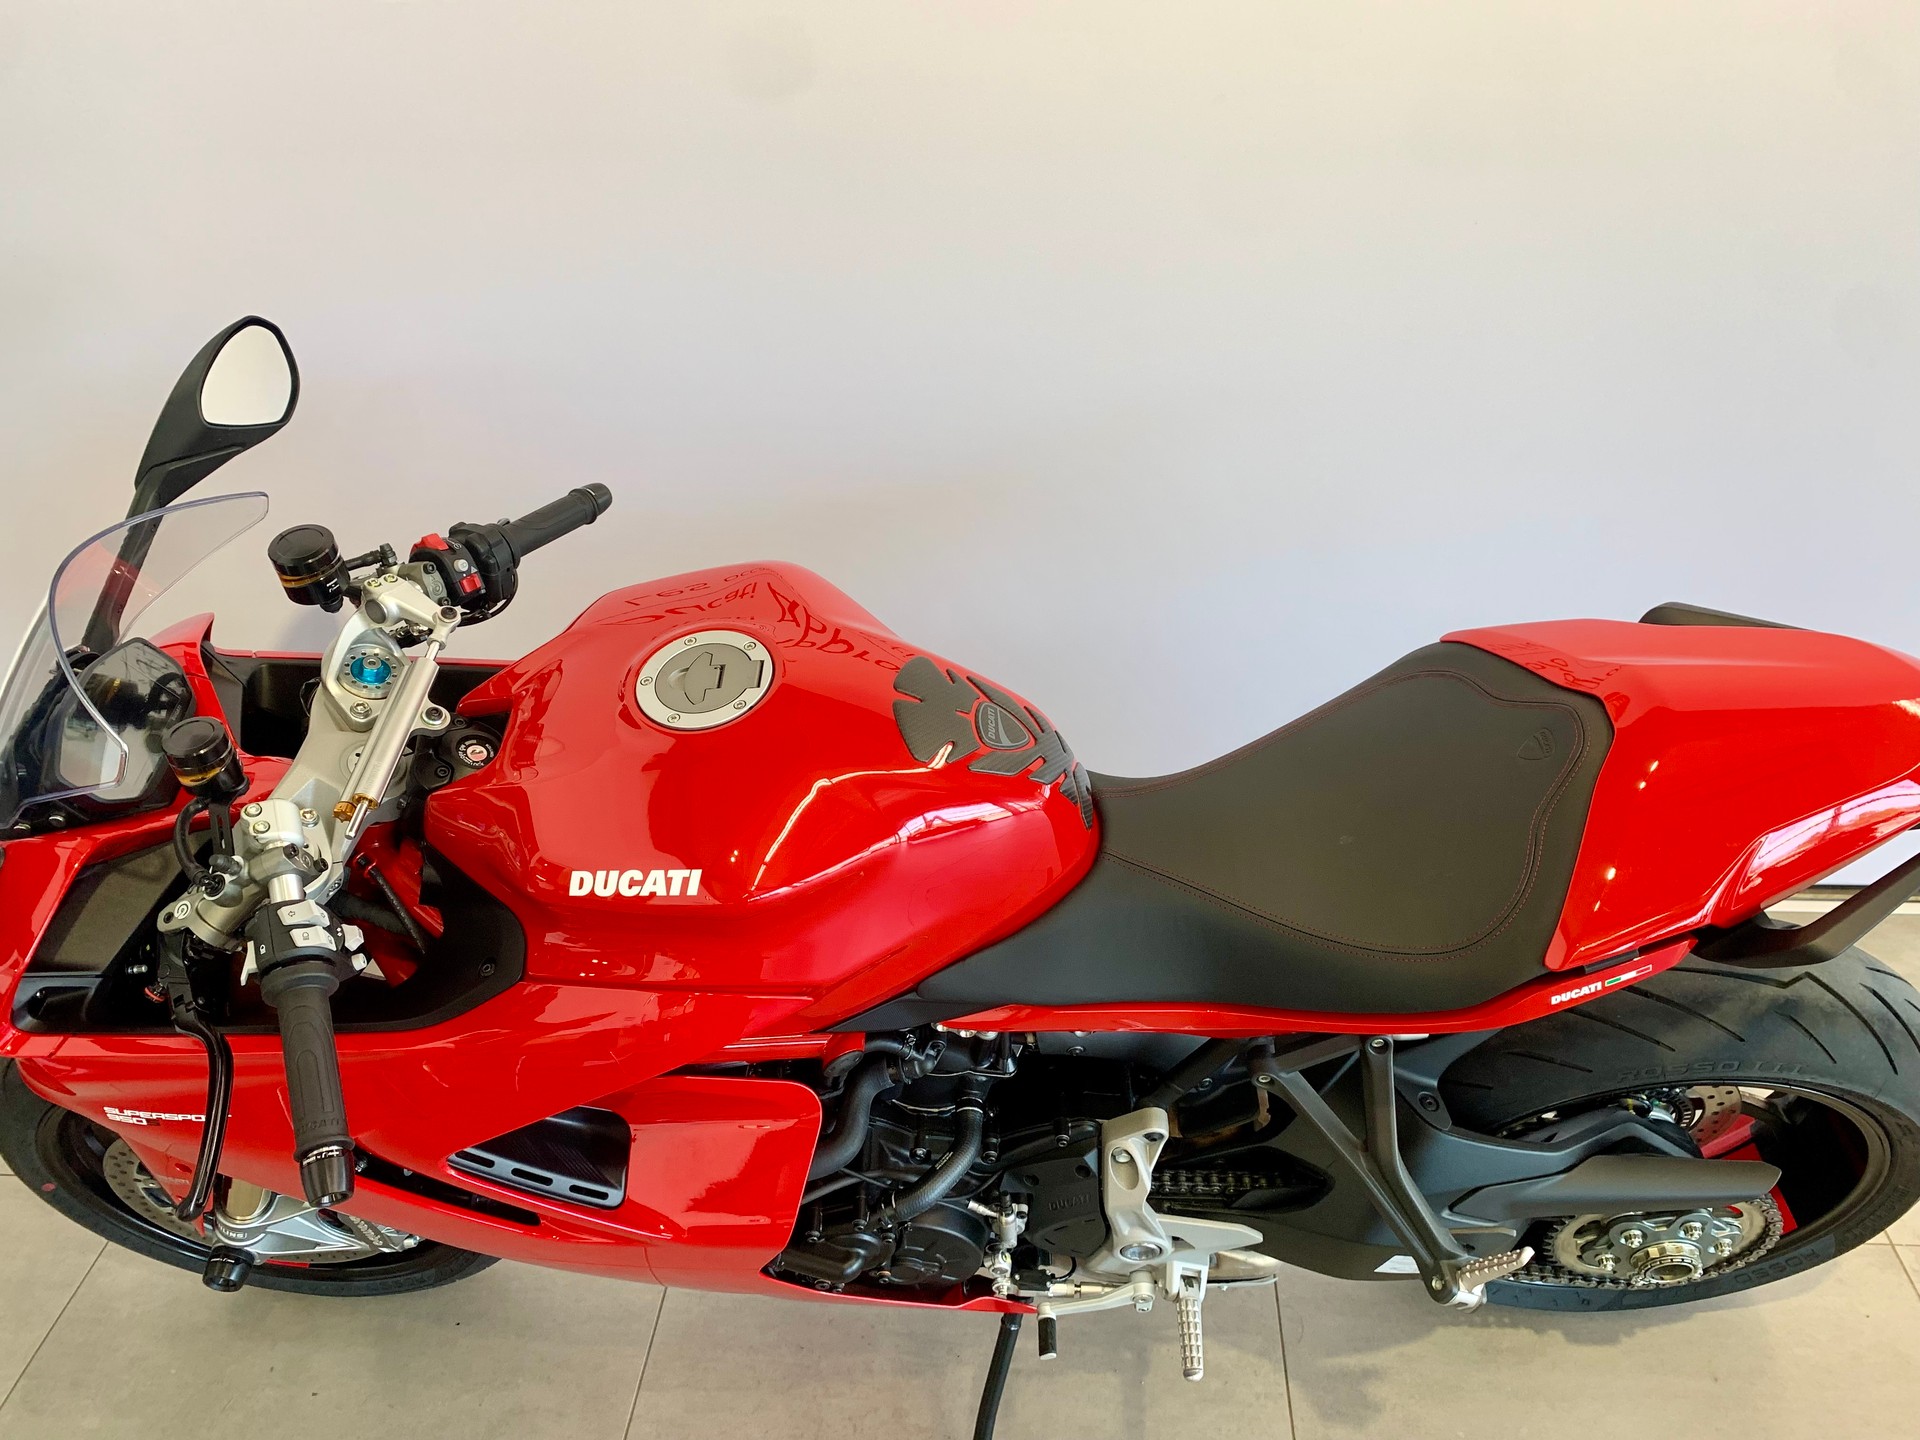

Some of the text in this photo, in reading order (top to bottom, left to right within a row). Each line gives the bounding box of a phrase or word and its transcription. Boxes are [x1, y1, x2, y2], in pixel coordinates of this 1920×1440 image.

[987, 707, 996, 740] DUCATI
[568, 869, 702, 897] DUCATI
[1550, 981, 1602, 1005] DUCATI
[1617, 1060, 1742, 1084] ROSSO
[103, 1106, 232, 1122] SUPERSPO
[1048, 1194, 1090, 1211] DUCATI
[1734, 1248, 1821, 1285] ROSSO
